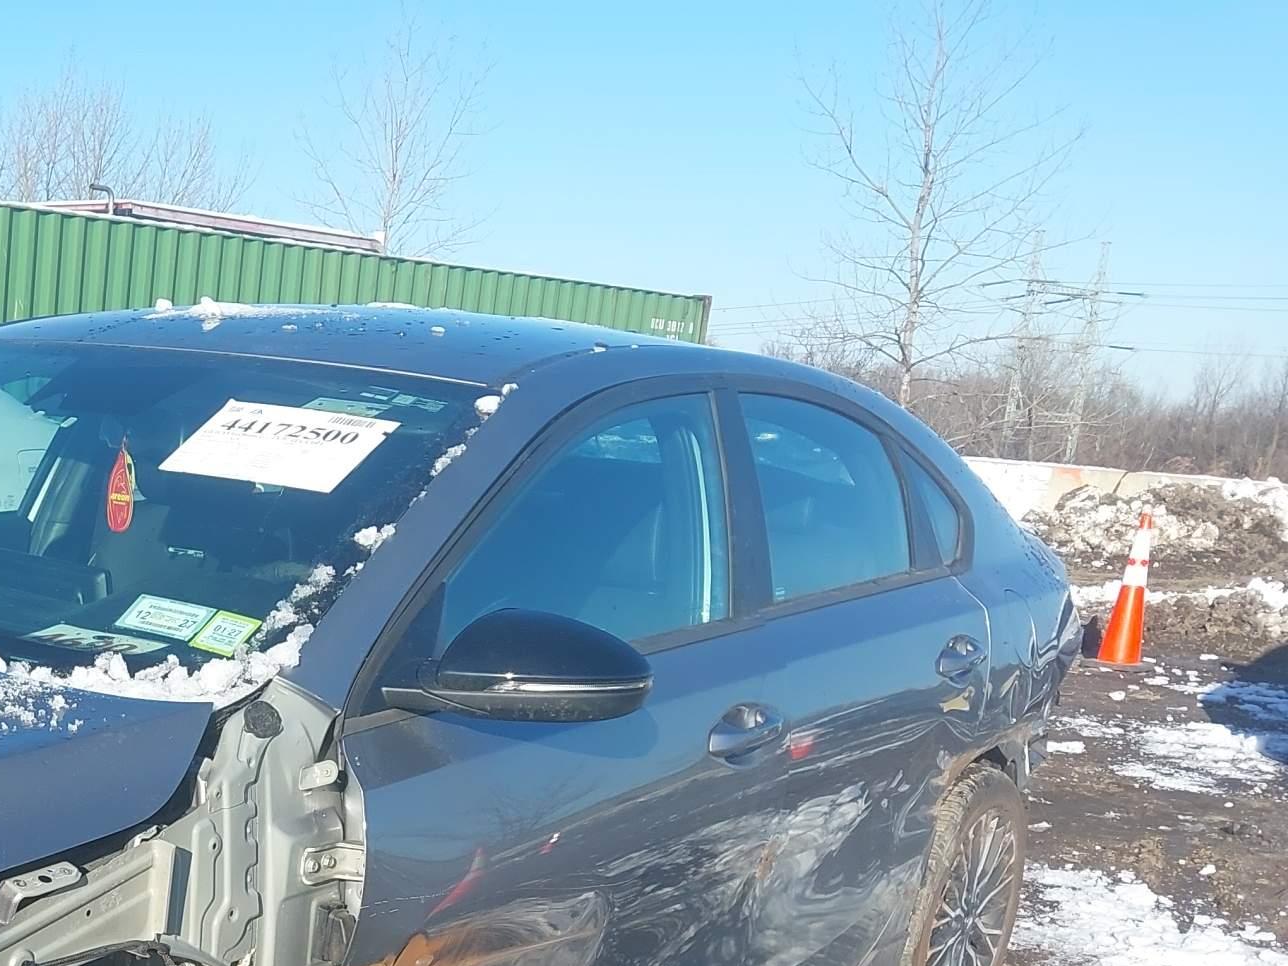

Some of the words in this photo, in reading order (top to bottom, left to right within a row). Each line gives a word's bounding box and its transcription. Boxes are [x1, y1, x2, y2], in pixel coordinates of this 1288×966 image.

[220, 418, 361, 446] 44172500
[136, 609, 152, 620] 12
[178, 618, 198, 630] 27
